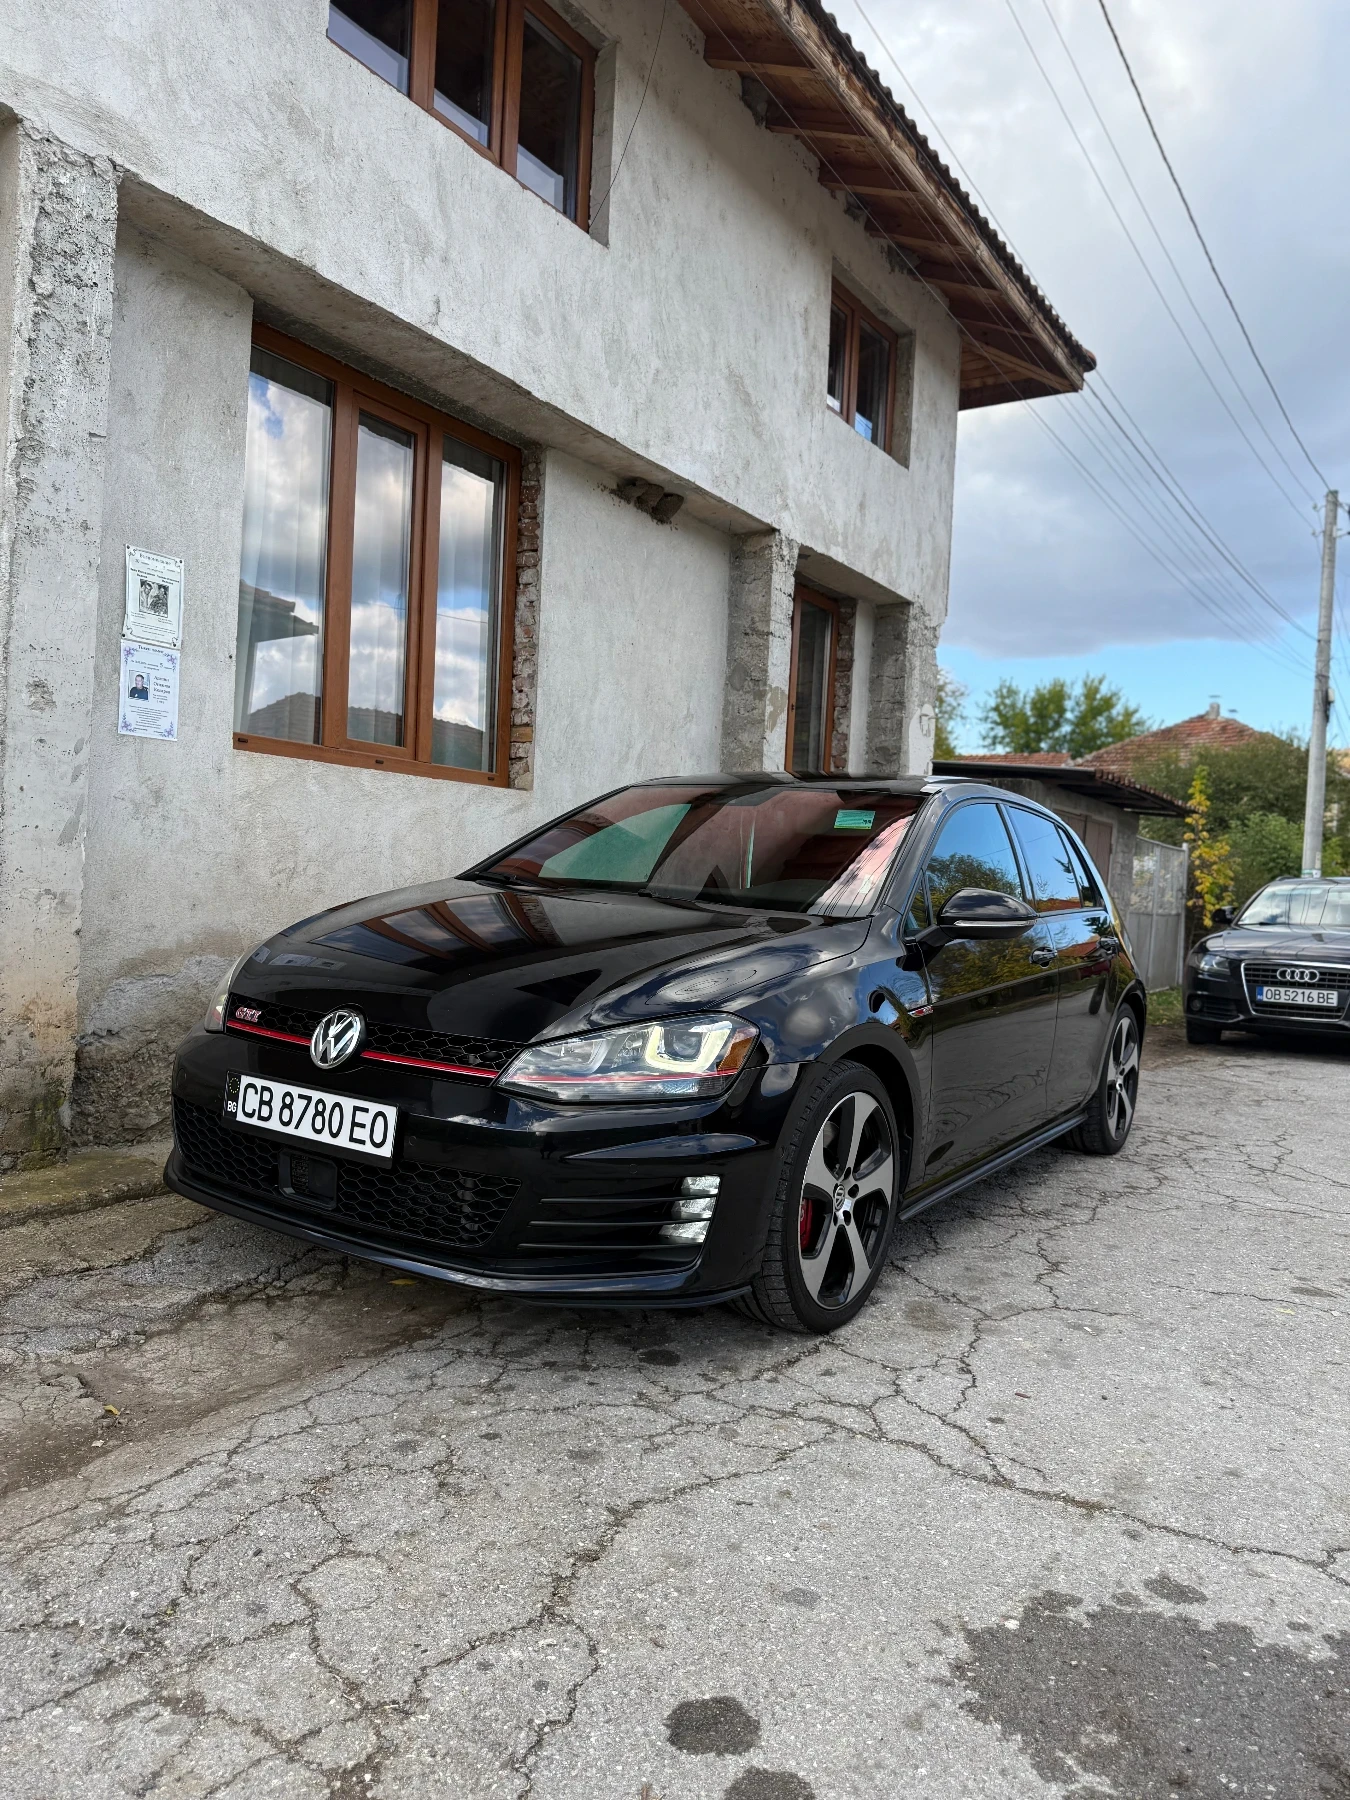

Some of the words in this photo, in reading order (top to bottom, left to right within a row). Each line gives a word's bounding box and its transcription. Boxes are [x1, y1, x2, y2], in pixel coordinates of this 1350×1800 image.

[1283, 989, 1315, 1003] 5216
[1317, 992, 1335, 1005] BE
[235, 1006, 262, 1023] GTI
[227, 1100, 237, 1113] BG
[241, 1082, 274, 1122] CB
[278, 1091, 344, 1139] 8780
